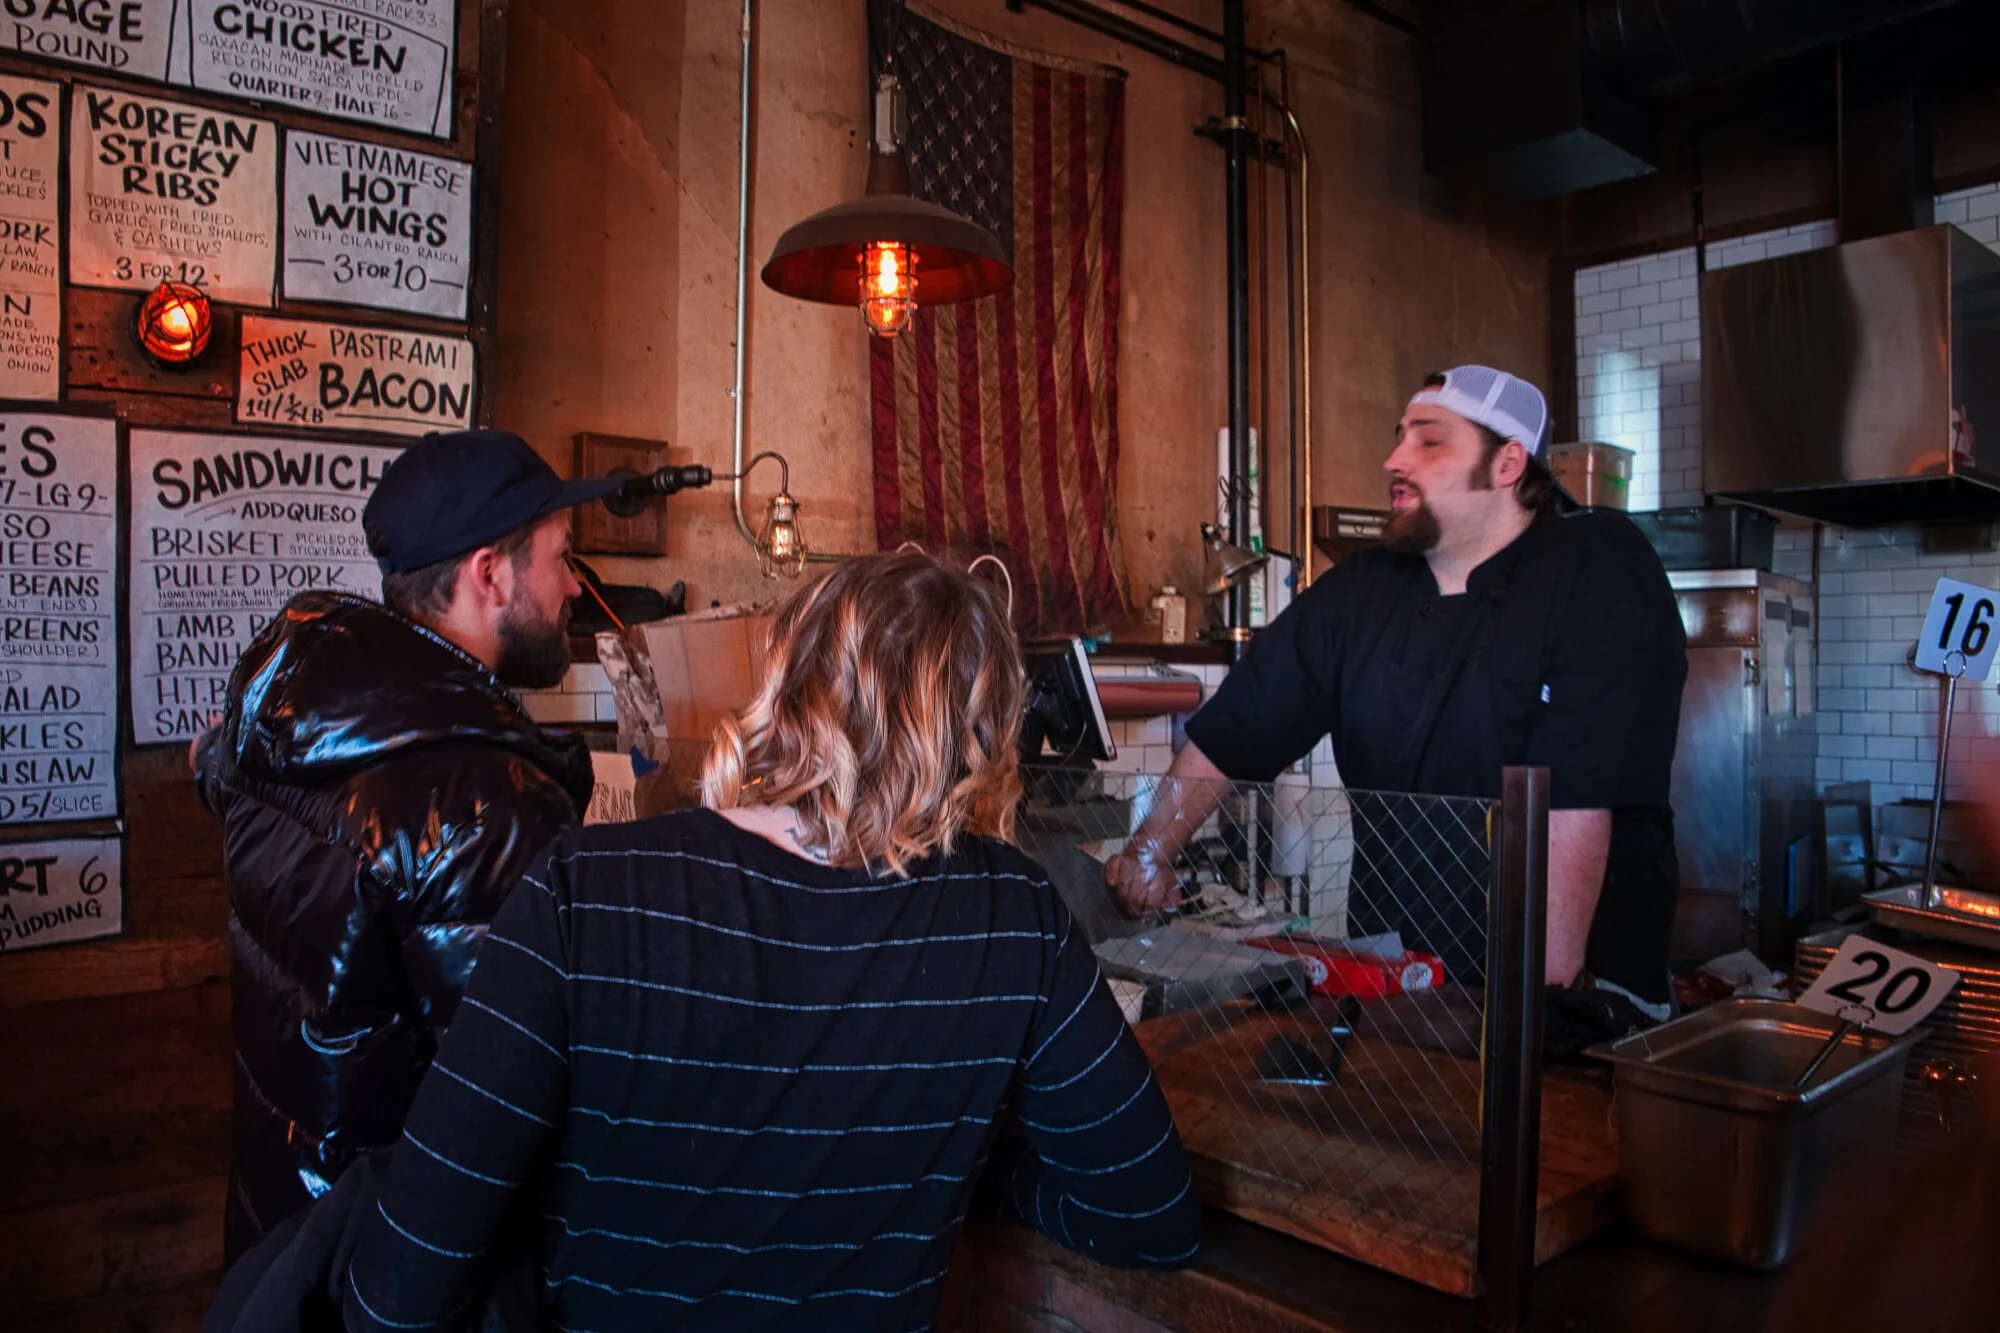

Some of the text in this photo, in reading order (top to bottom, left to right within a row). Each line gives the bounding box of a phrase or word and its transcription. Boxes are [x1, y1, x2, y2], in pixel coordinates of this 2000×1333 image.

[213, 4, 407, 75] CHICKEN
[242, 0, 392, 41] WOOD FIRED
[14, 22, 129, 68] POUND
[198, 32, 272, 59] OAXACAN
[211, 49, 245, 68] RED
[308, 69, 352, 91] SALSA
[228, 71, 311, 101] QUARTER
[335, 91, 378, 116] HALF
[0, 88, 50, 138] S
[87, 91, 258, 153] KOREAN
[99, 133, 240, 179] STICKY
[294, 139, 464, 197] VIETNAMESE
[0, 165, 46, 186] UCE,
[122, 165, 220, 207] RIBS
[341, 170, 419, 208] HOT
[86, 191, 235, 226] TOPPED WITH FRIED
[88, 209, 153, 230] GARLIC,
[160, 219, 203, 235] FRIED
[307, 193, 449, 249] WINGS
[0, 244, 39, 262] LAW,
[131, 229, 222, 255] CASHEWS
[293, 225, 459, 266] WITH CILANTRO RANCH
[10, 258, 55, 278] RANCH
[115, 255, 209, 287] 3 FOR 12
[333, 253, 427, 292] 3 FOR 10
[0, 316, 37, 332] ADE,
[7, 358, 51, 374] ONION
[243, 329, 316, 367] THICK
[329, 328, 457, 370] PASTRAMI
[252, 358, 309, 397] SLAB
[318, 361, 470, 420] BACON
[152, 448, 391, 511] SANDWICH
[0, 512, 51, 540] SO
[241, 501, 357, 525] ADD QUESO
[0, 540, 94, 568] EESE
[151, 526, 285, 557] BRISKET
[295, 531, 345, 545] PICKLED
[288, 544, 328, 557] STICKY
[9, 572, 100, 599] BEANS
[153, 563, 349, 590] PULLED PORK
[0, 617, 100, 643] REENS
[156, 613, 235, 639] LAMB
[1938, 592, 1995, 656] 16
[156, 641, 241, 672] BANH
[0, 684, 81, 712] ALAD
[0, 854, 108, 896] RT 6
[0, 898, 103, 950] PUDDING
[1824, 951, 1932, 1024] 20
